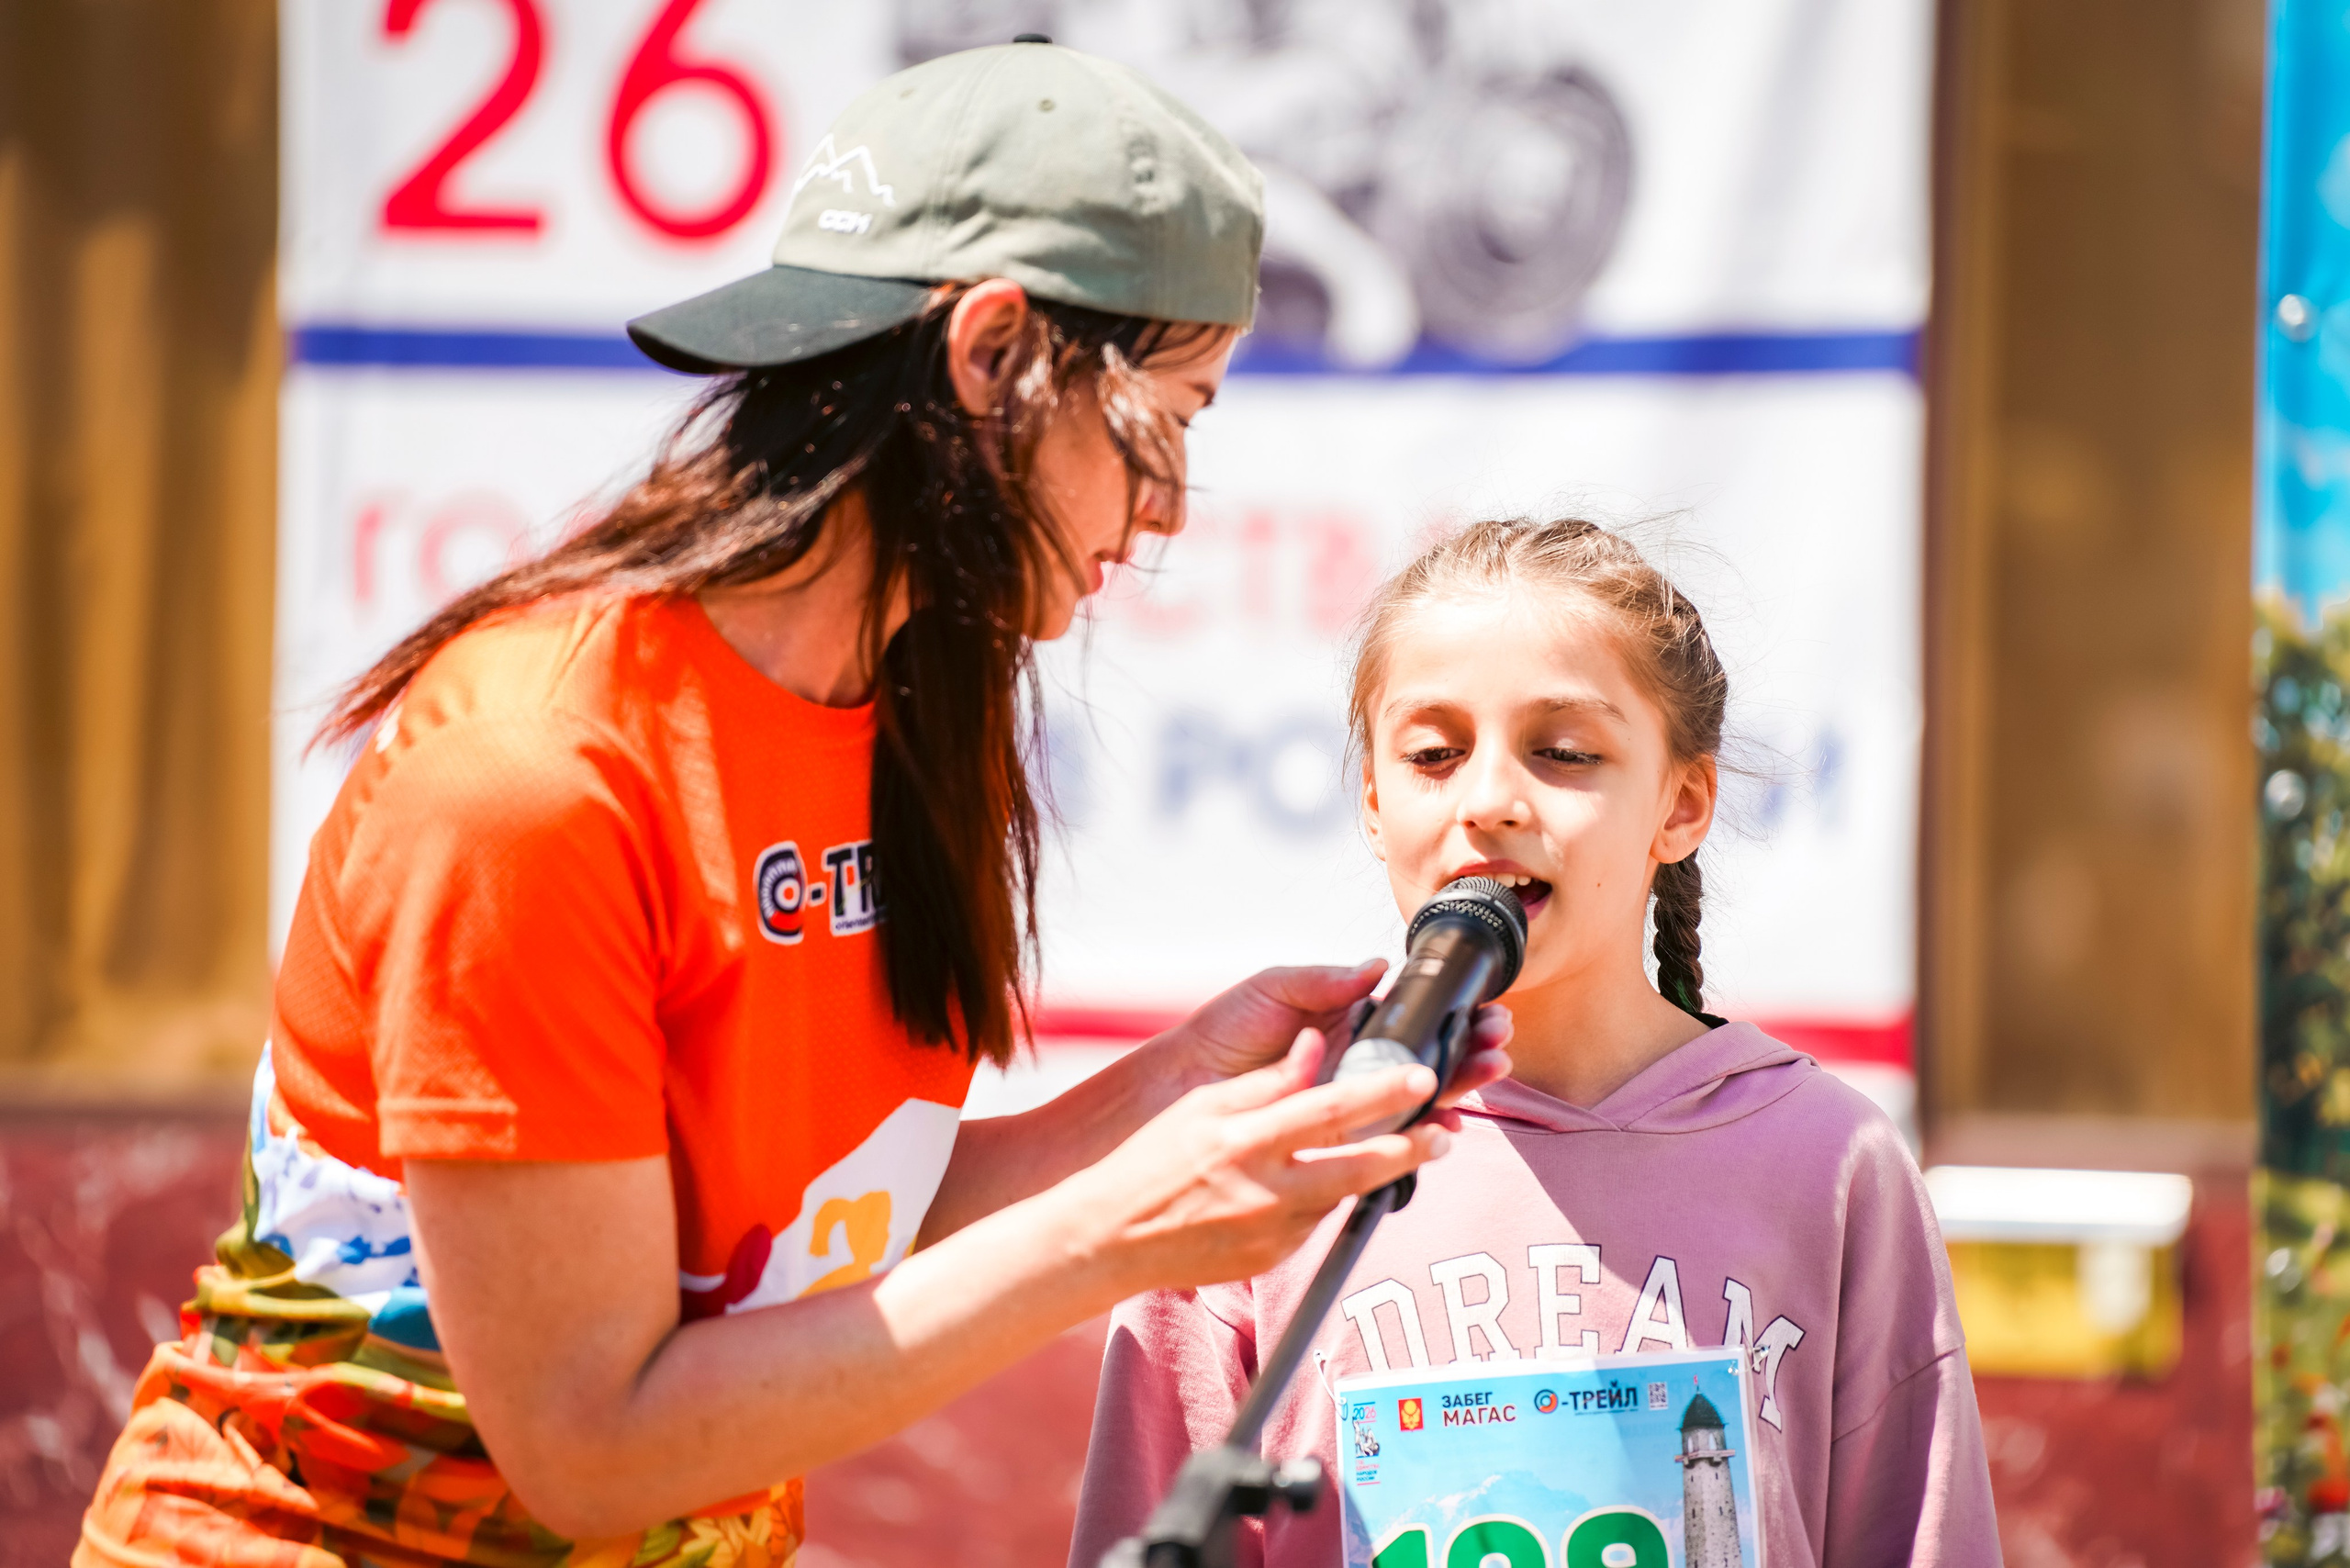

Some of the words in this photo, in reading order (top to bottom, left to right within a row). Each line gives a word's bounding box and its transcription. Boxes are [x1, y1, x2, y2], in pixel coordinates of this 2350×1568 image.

[376, 0, 780, 241] 26
[1340, 1243, 1807, 1433] DREAM
[1441, 1392, 1494, 1408] ЗАБЕГ
[1353, 1406, 1377, 1420] 2026
[1443, 1405, 1516, 1427] МАГАС
